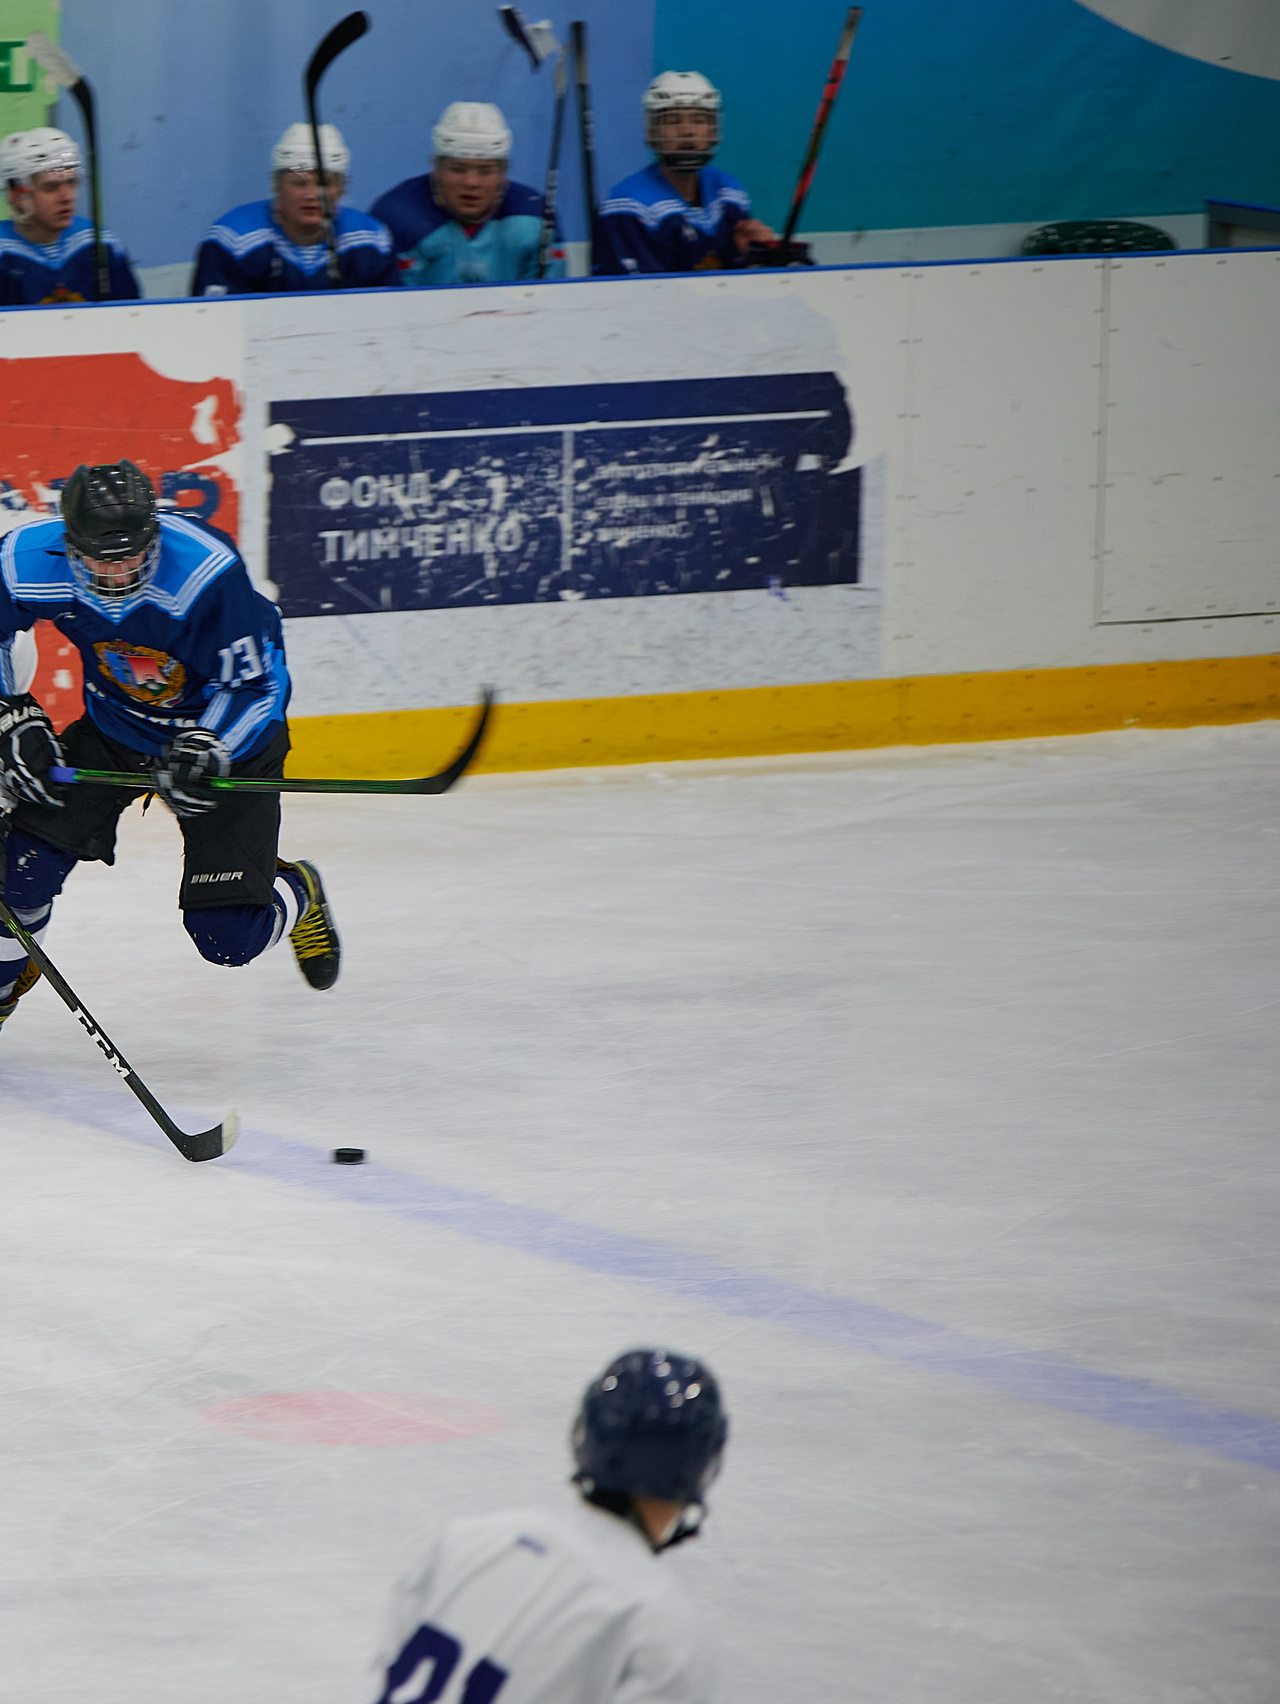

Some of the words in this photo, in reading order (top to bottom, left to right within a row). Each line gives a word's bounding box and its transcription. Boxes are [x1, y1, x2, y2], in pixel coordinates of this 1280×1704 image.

[320, 472, 434, 509] ФОНД
[218, 635, 264, 683] 13
[190, 871, 244, 885] BAUER
